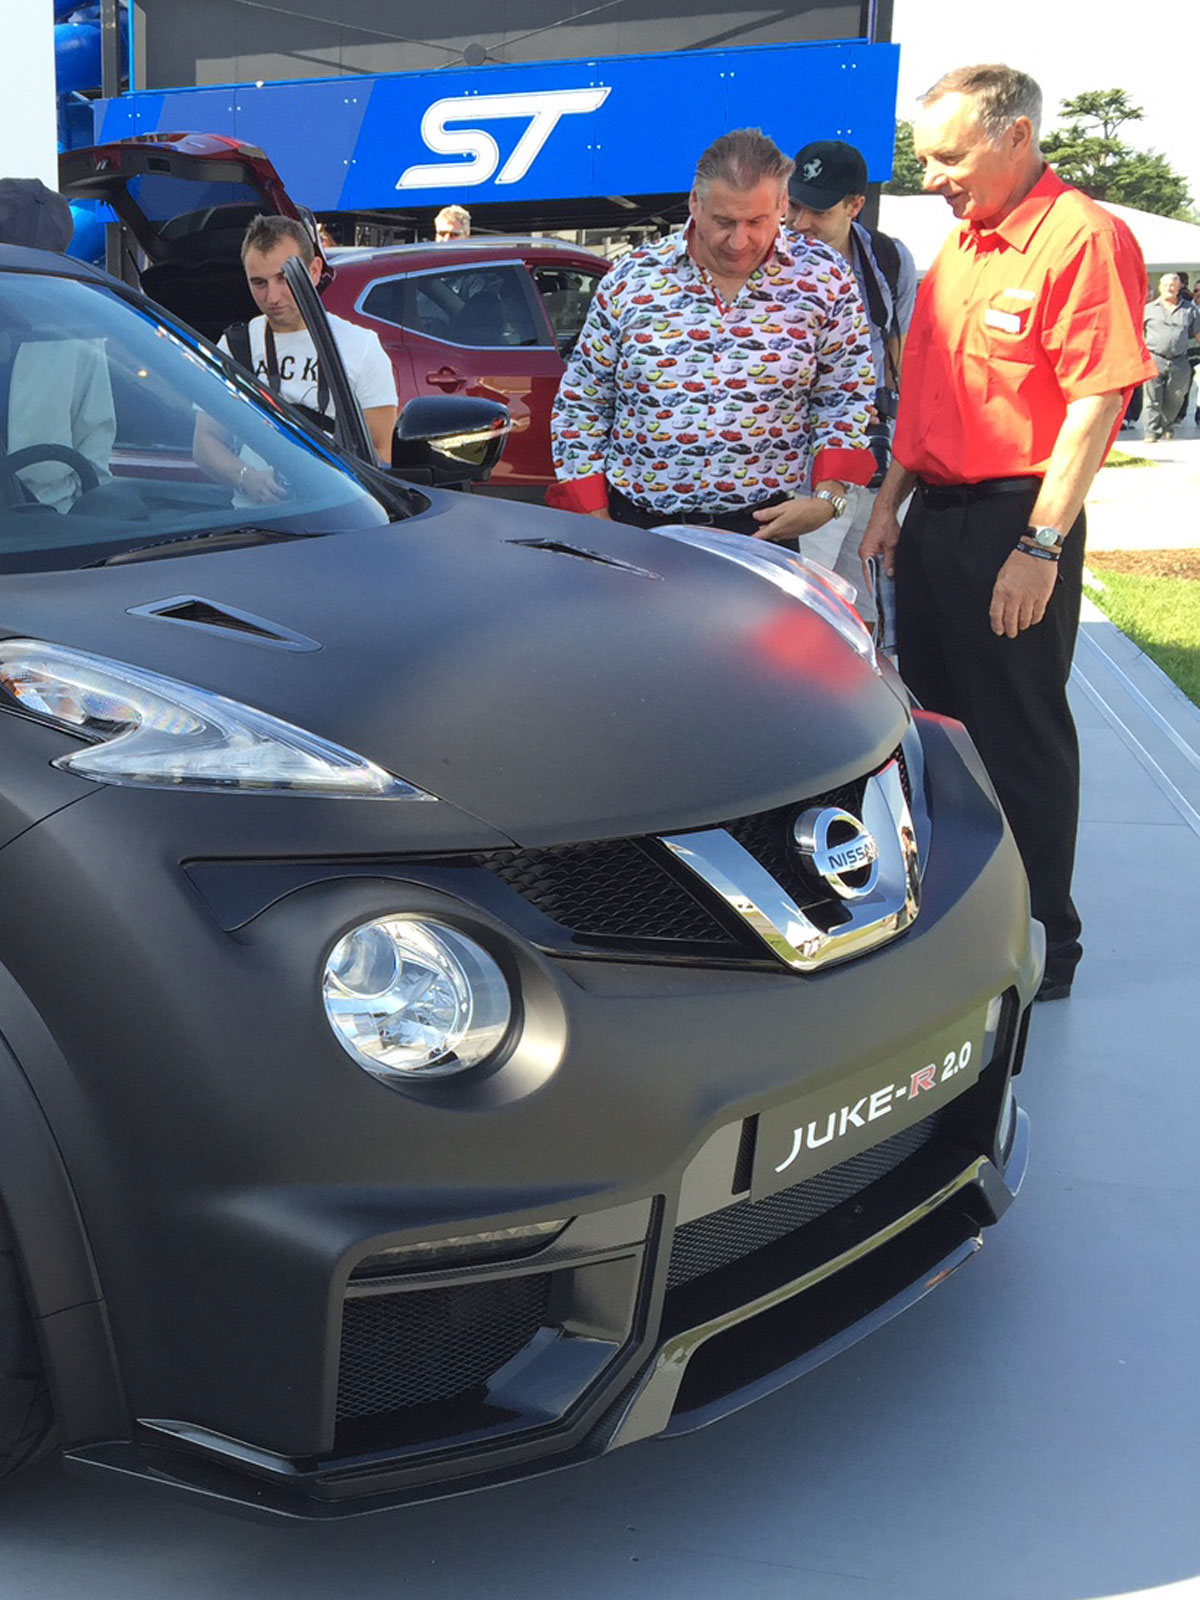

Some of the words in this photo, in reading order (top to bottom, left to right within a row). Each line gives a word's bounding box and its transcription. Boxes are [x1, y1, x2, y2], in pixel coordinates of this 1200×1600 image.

[395, 87, 612, 190] ST
[775, 1063, 936, 1173] JUKE-R
[940, 1041, 972, 1083] 2.0
